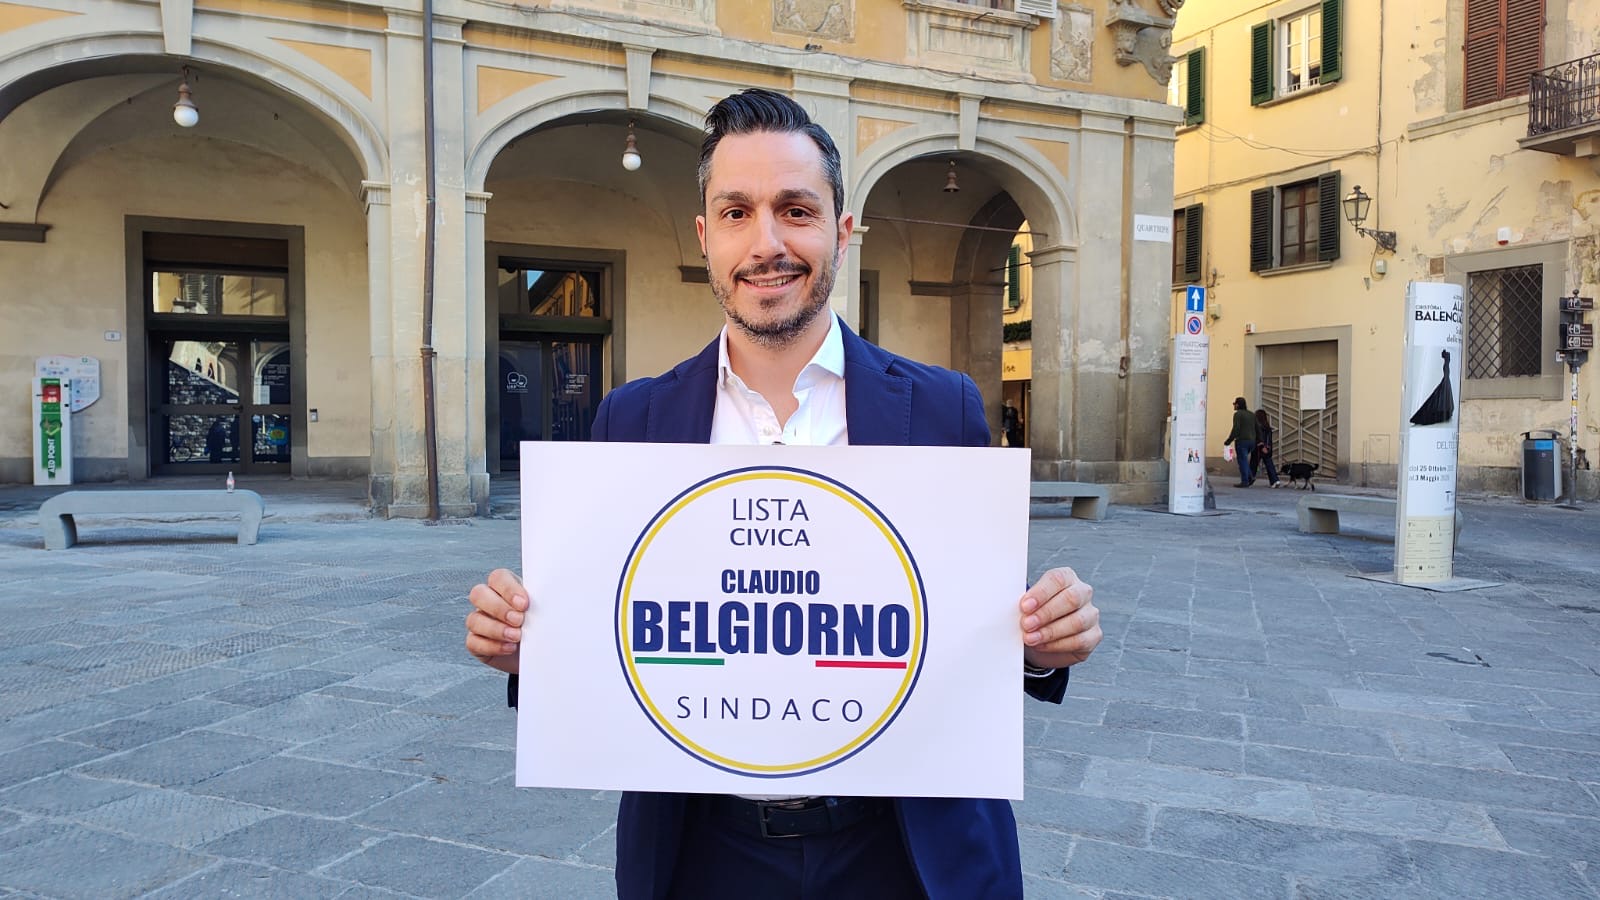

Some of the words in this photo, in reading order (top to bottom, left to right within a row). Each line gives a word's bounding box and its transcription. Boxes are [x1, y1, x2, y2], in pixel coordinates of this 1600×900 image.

[48, 438, 56, 459] POINT
[733, 498, 809, 522] LISTA
[730, 528, 811, 547] CIVICA
[721, 569, 820, 595] CLAUDIO
[632, 600, 910, 657] BELGIORNO
[677, 696, 863, 723] SINDACO
